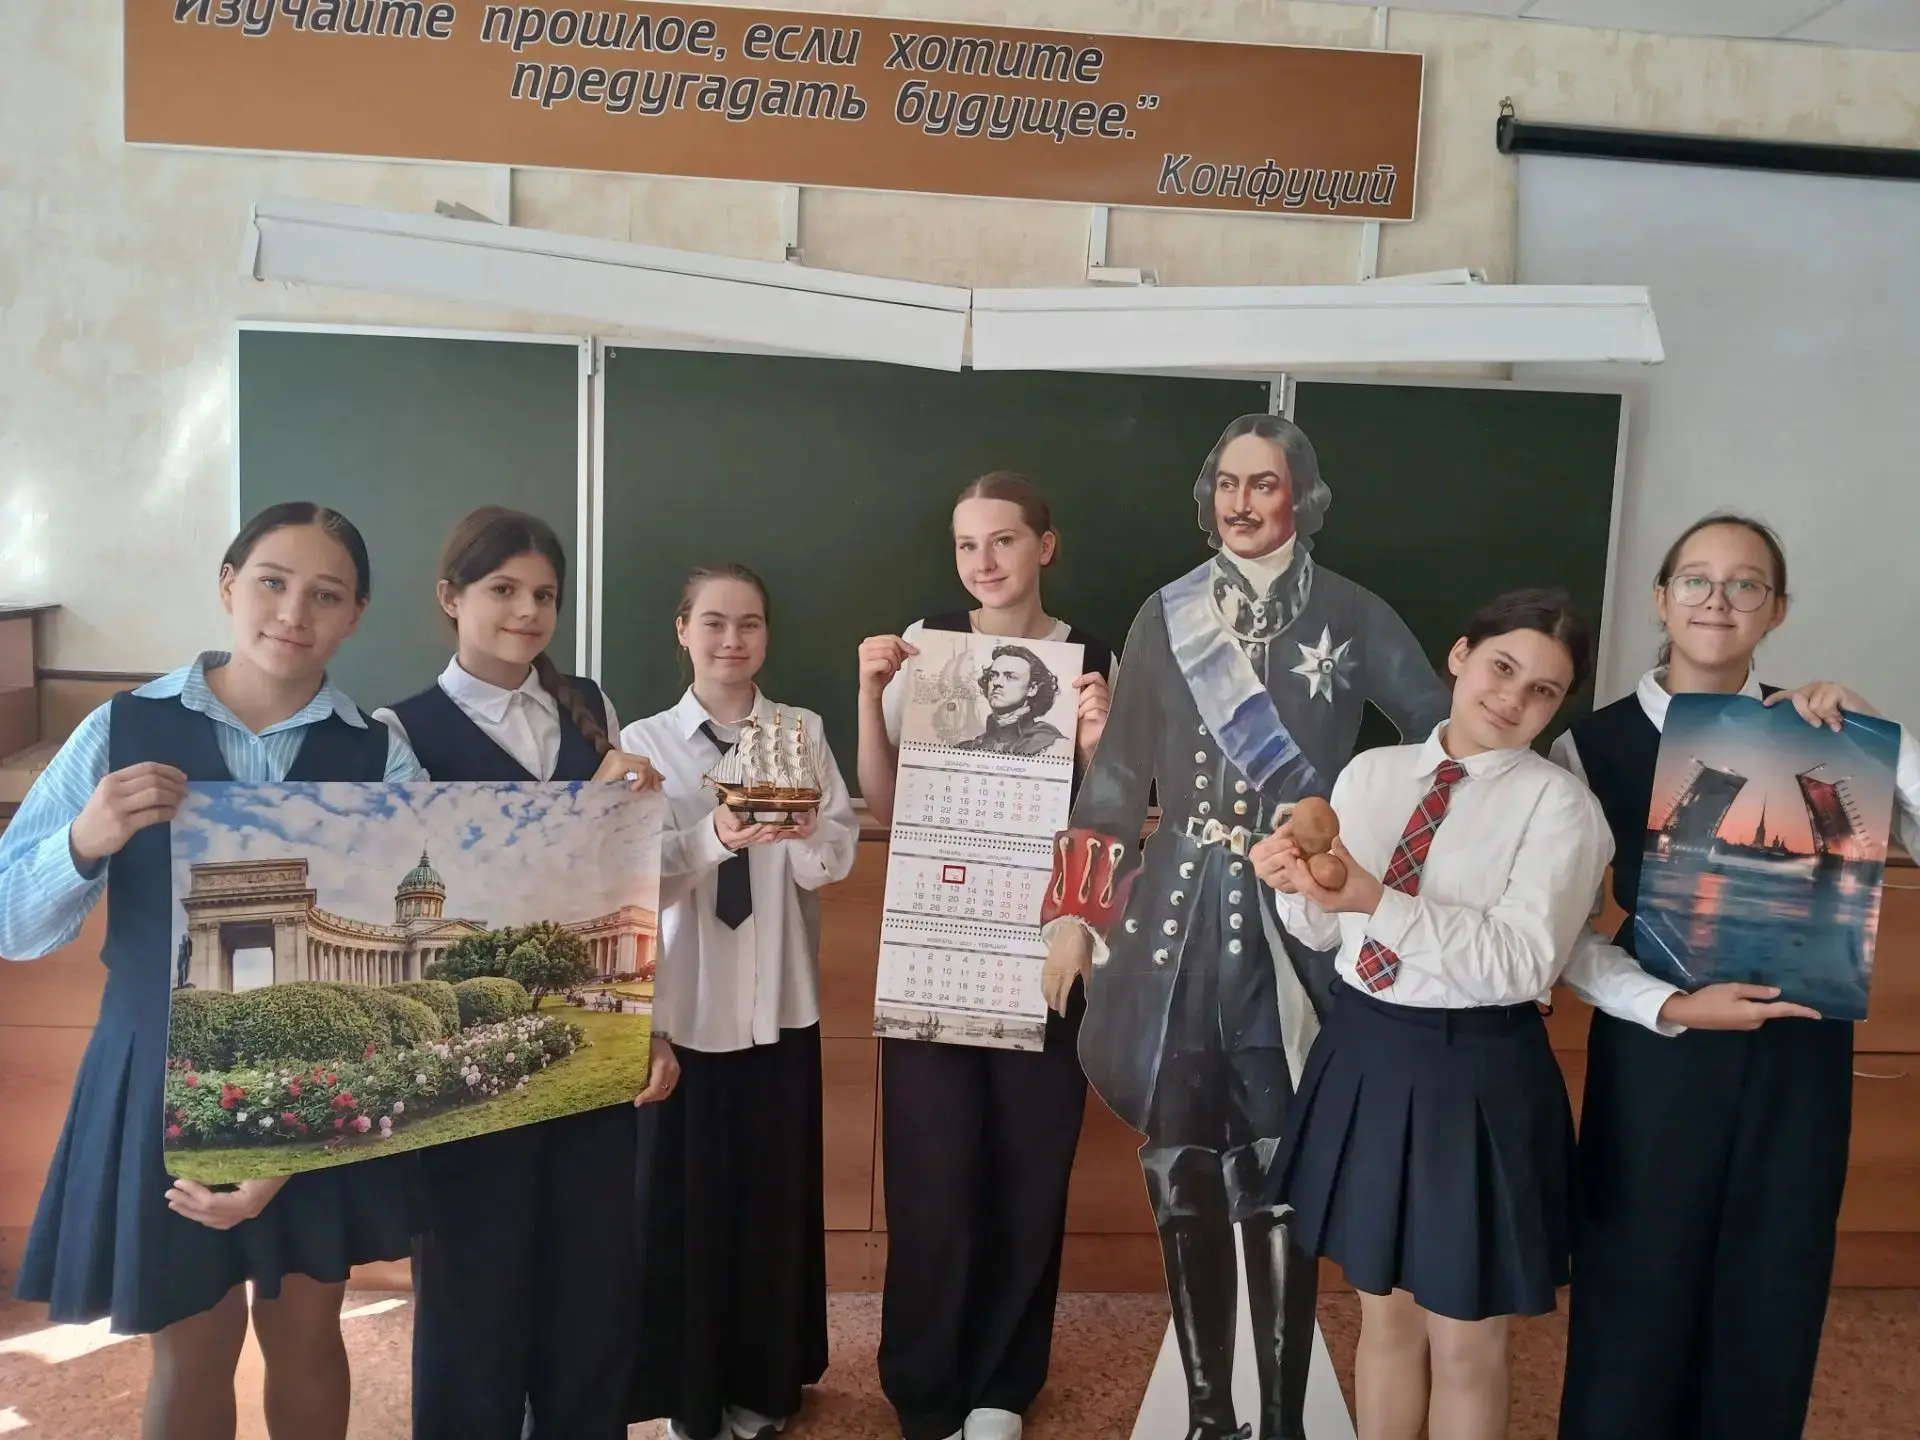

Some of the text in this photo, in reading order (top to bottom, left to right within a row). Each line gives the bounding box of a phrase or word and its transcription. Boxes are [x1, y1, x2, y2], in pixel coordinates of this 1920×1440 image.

[480, 3, 728, 61] прошлое,
[742, 22, 862, 66] если
[884, 32, 1104, 83] хотите
[511, 61, 867, 122] предугадать
[1157, 153, 1397, 210] Конфуций
[978, 788, 989, 796] 10
[924, 794, 936, 802] 14
[941, 795, 953, 803] 15
[959, 797, 971, 805] 16
[976, 799, 988, 807] 17
[994, 800, 1006, 809] 18
[1029, 804, 1040, 812] 20
[921, 814, 933, 823] 28
[923, 804, 934, 812] 21
[940, 806, 952, 814] 22
[958, 807, 969, 816] 23
[975, 809, 987, 817] 24
[992, 811, 1004, 819] 25
[1028, 814, 1039, 823] 27
[914, 881, 926, 890] 11
[1001, 890, 1013, 899] 16
[1018, 892, 1030, 900] 17
[1020, 882, 1031, 890] 10
[913, 891, 925, 900] 18
[930, 893, 942, 901] 19
[948, 895, 959, 903] 20
[965, 897, 977, 905] 21
[1000, 900, 1012, 909] 23
[1017, 902, 1029, 911] 24
[929, 903, 941, 912] 26
[946, 905, 958, 913] 27
[964, 907, 976, 915] 28
[981, 909, 993, 917] 29
[998, 911, 1010, 919] 30
[941, 967, 953, 975] 10
[976, 971, 988, 979] 12
[905, 977, 917, 985] 15
[957, 982, 969, 990] 18
[975, 984, 986, 992] 19
[992, 985, 1004, 994] 20
[1009, 987, 1021, 995] 21
[904, 990, 916, 998] 22
[921, 992, 933, 1000] 23
[938, 993, 950, 1001] 24
